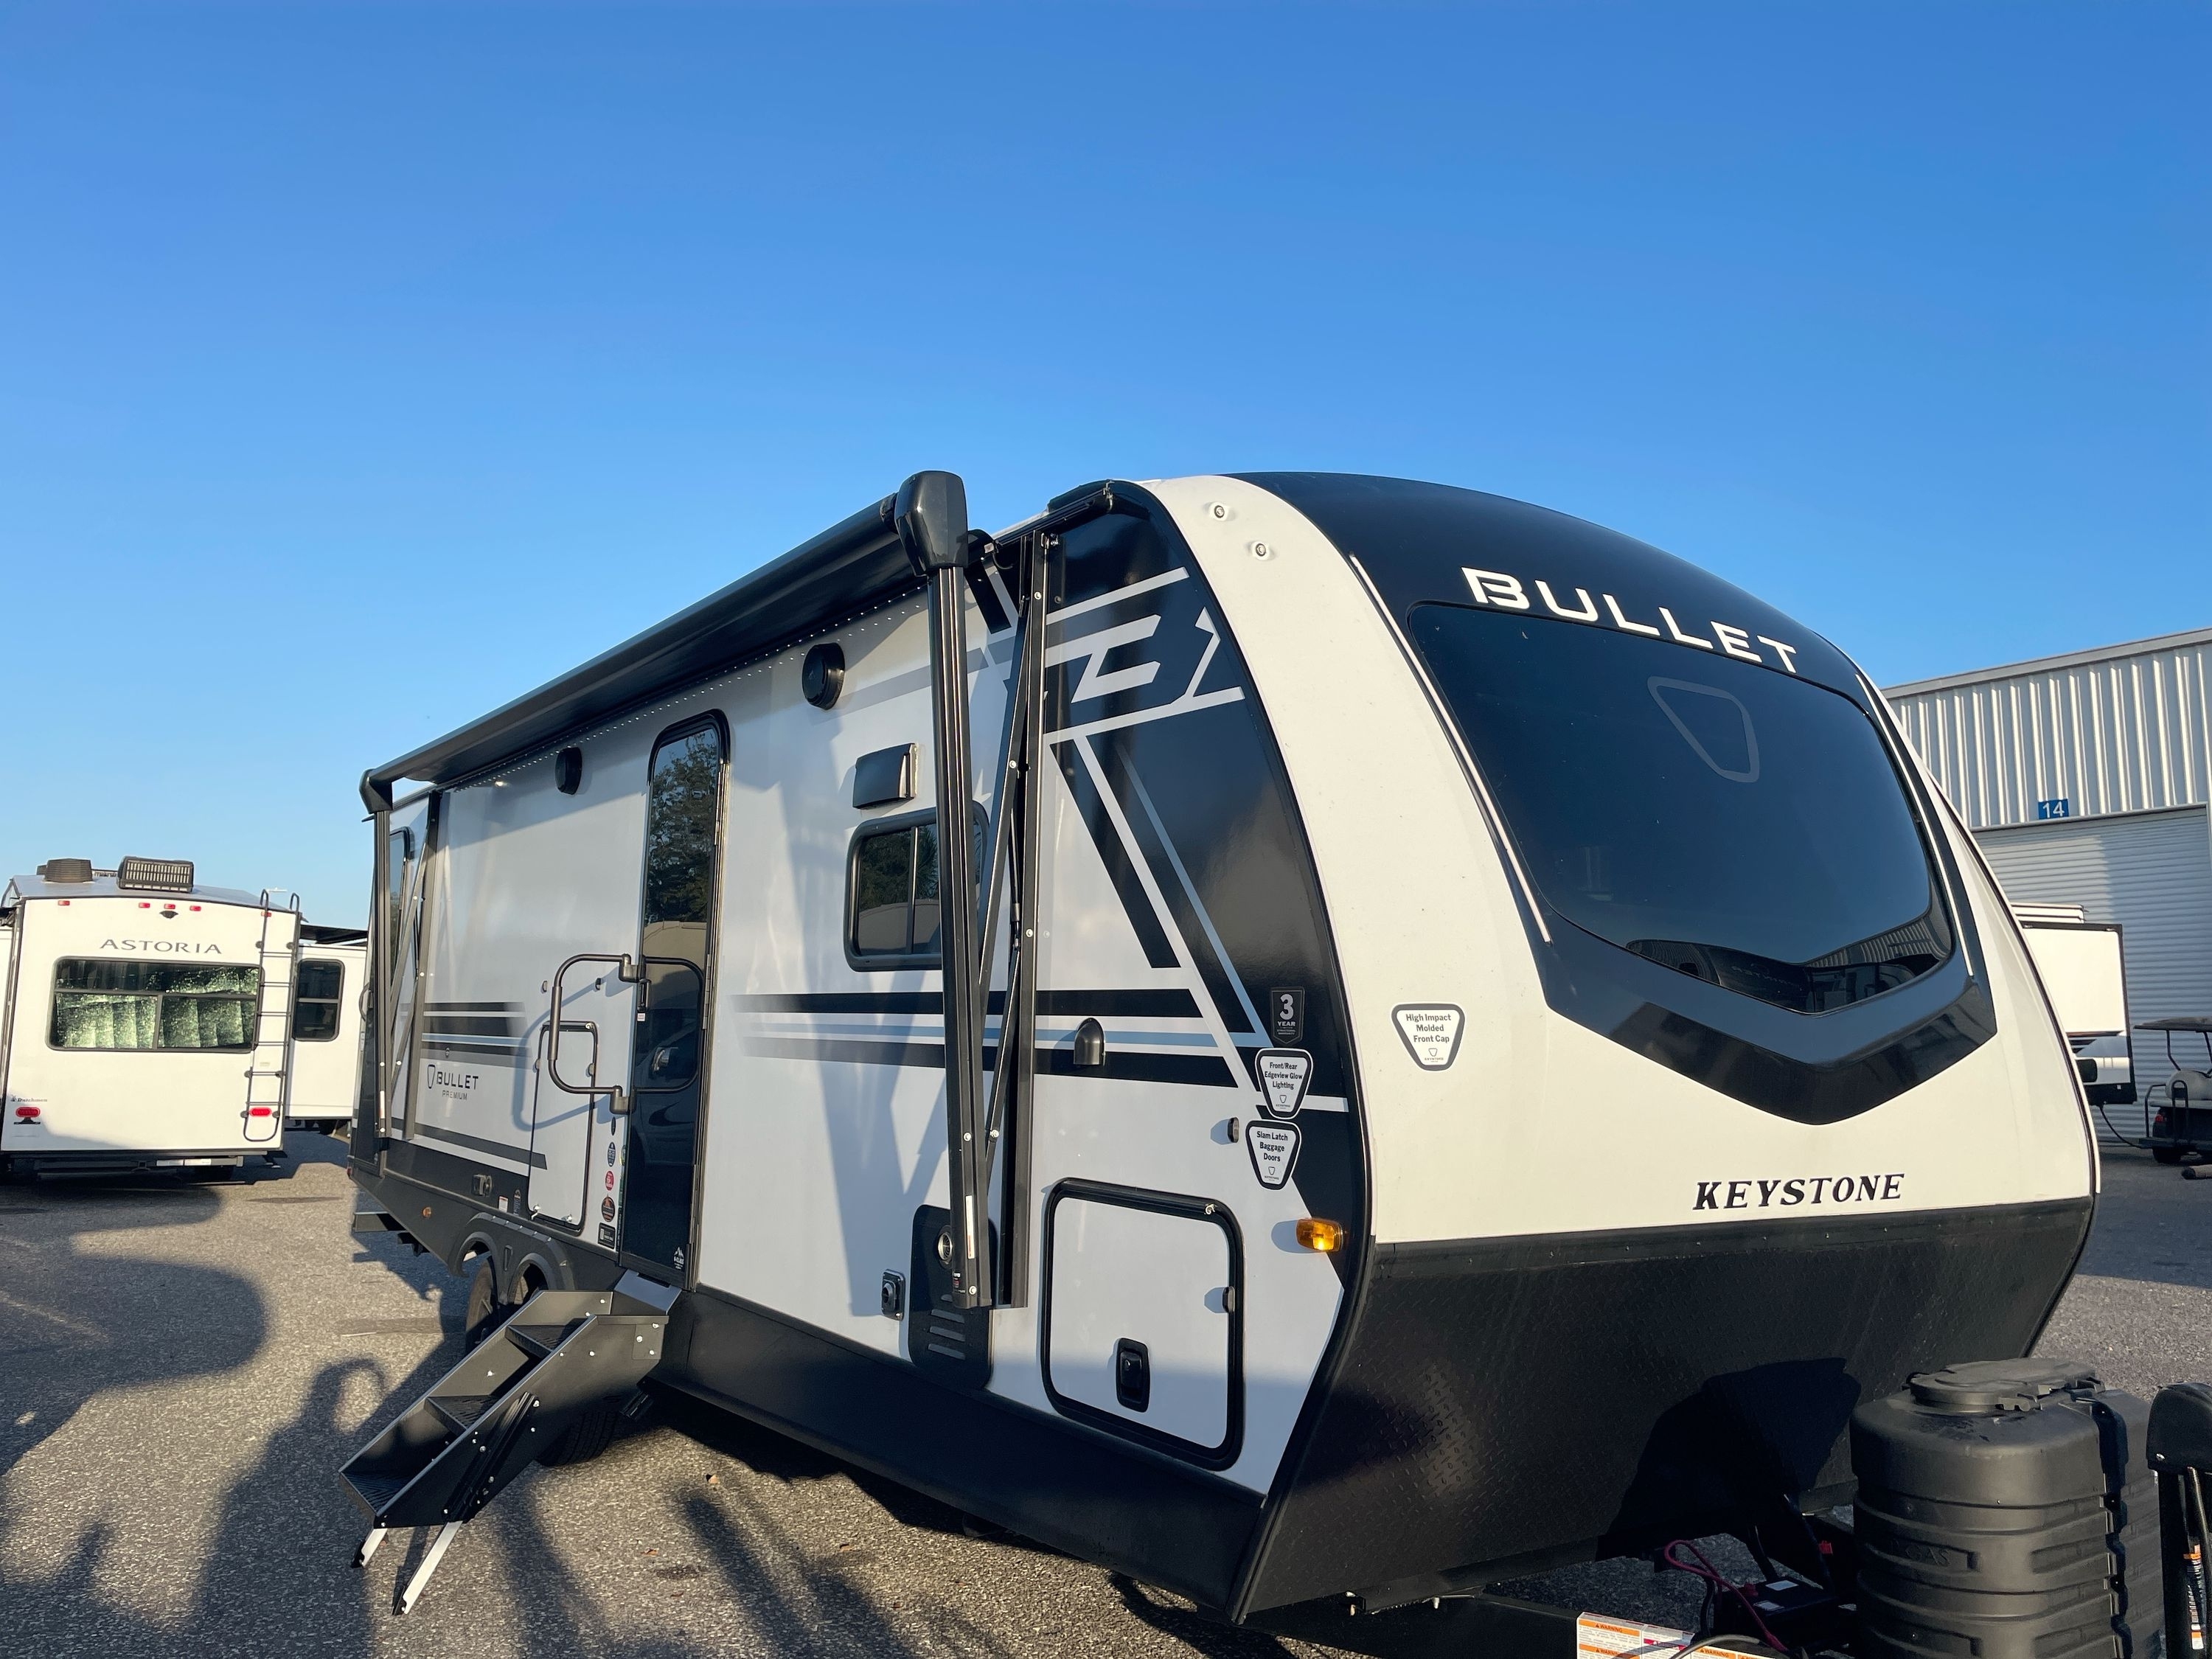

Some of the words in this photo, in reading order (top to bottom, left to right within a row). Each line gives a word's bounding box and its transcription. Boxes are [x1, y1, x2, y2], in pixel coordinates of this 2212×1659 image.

[1460, 566, 1798, 673] BULLET
[2042, 801, 2065, 818] 14
[100, 939, 222, 954] ASTORIA
[1279, 993, 1294, 1020] 3
[1405, 1013, 1424, 1023] High
[1425, 1013, 1452, 1023] Impact
[1416, 1023, 1444, 1032] Molded
[1413, 1034, 1434, 1043] Front
[1435, 1034, 1450, 1043] Cap
[1270, 1062, 1298, 1071] Front/Rear
[1265, 1071, 1289, 1079] Edgeview
[437, 1071, 479, 1090] BULLET
[1272, 1081, 1295, 1090] Lighting
[442, 1090, 467, 1100] PREMIUM
[1256, 1130, 1271, 1139] Slam
[1271, 1132, 1288, 1141] Latch
[1259, 1141, 1285, 1153] Baggage
[1263, 1152, 1281, 1162] Doors
[1692, 1173, 1905, 1211] KEYSTONE
[1600, 1624, 1622, 1632] WARNING
[1705, 1648, 1729, 1658] WARNING
